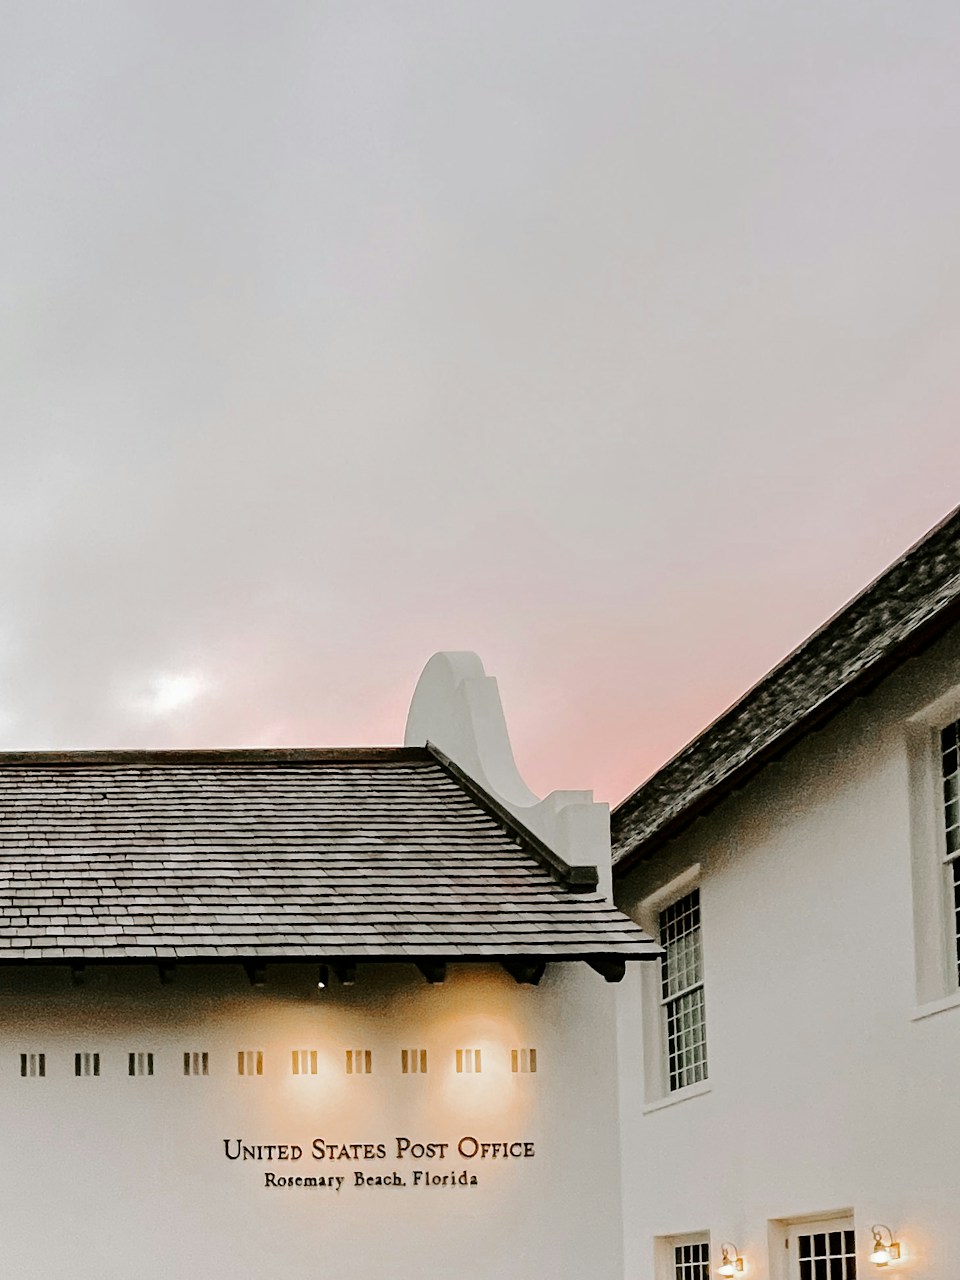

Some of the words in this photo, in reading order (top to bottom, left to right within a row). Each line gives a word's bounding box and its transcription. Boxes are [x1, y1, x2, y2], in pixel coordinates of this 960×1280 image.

[395, 1137, 449, 1160] POST
[264, 1172, 345, 1191] Rosemary
[354, 1171, 407, 1187] Beach,
[413, 1171, 479, 1186] Florida
